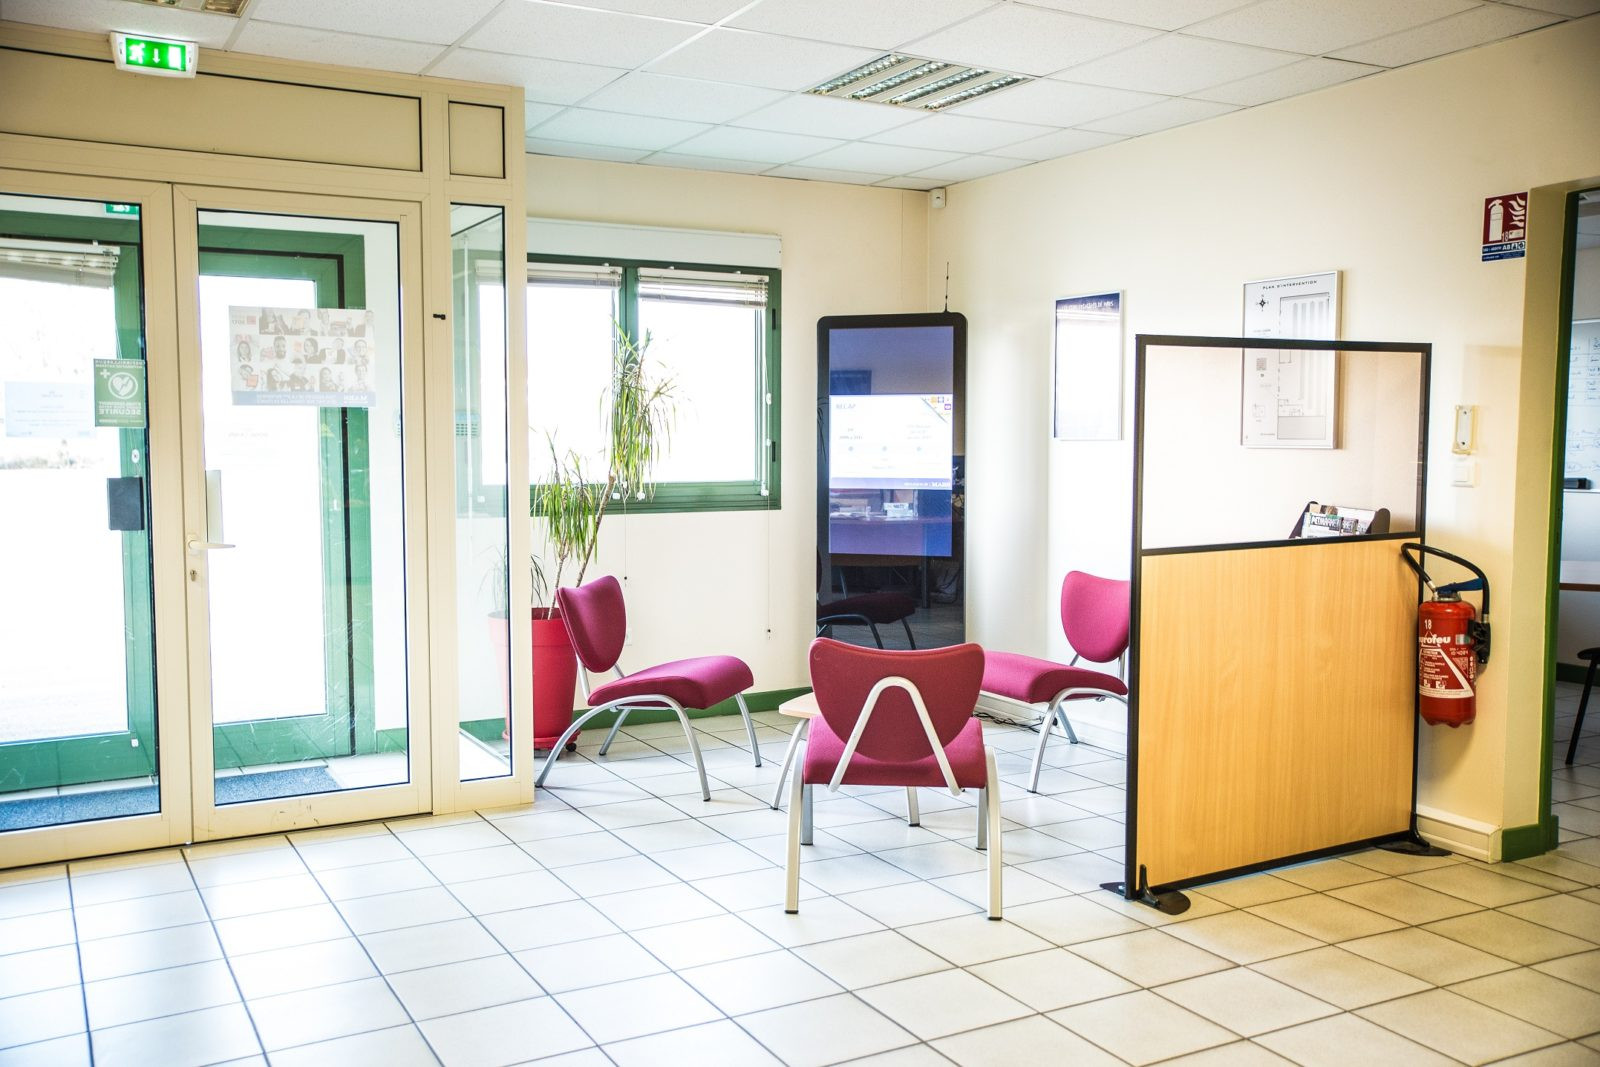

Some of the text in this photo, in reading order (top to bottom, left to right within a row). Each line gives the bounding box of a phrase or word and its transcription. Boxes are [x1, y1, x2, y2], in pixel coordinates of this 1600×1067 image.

[1277, 280, 1318, 288] D'INTERVENTION
[1424, 619, 1432, 630] 18
[1419, 633, 1451, 644] urofeu
